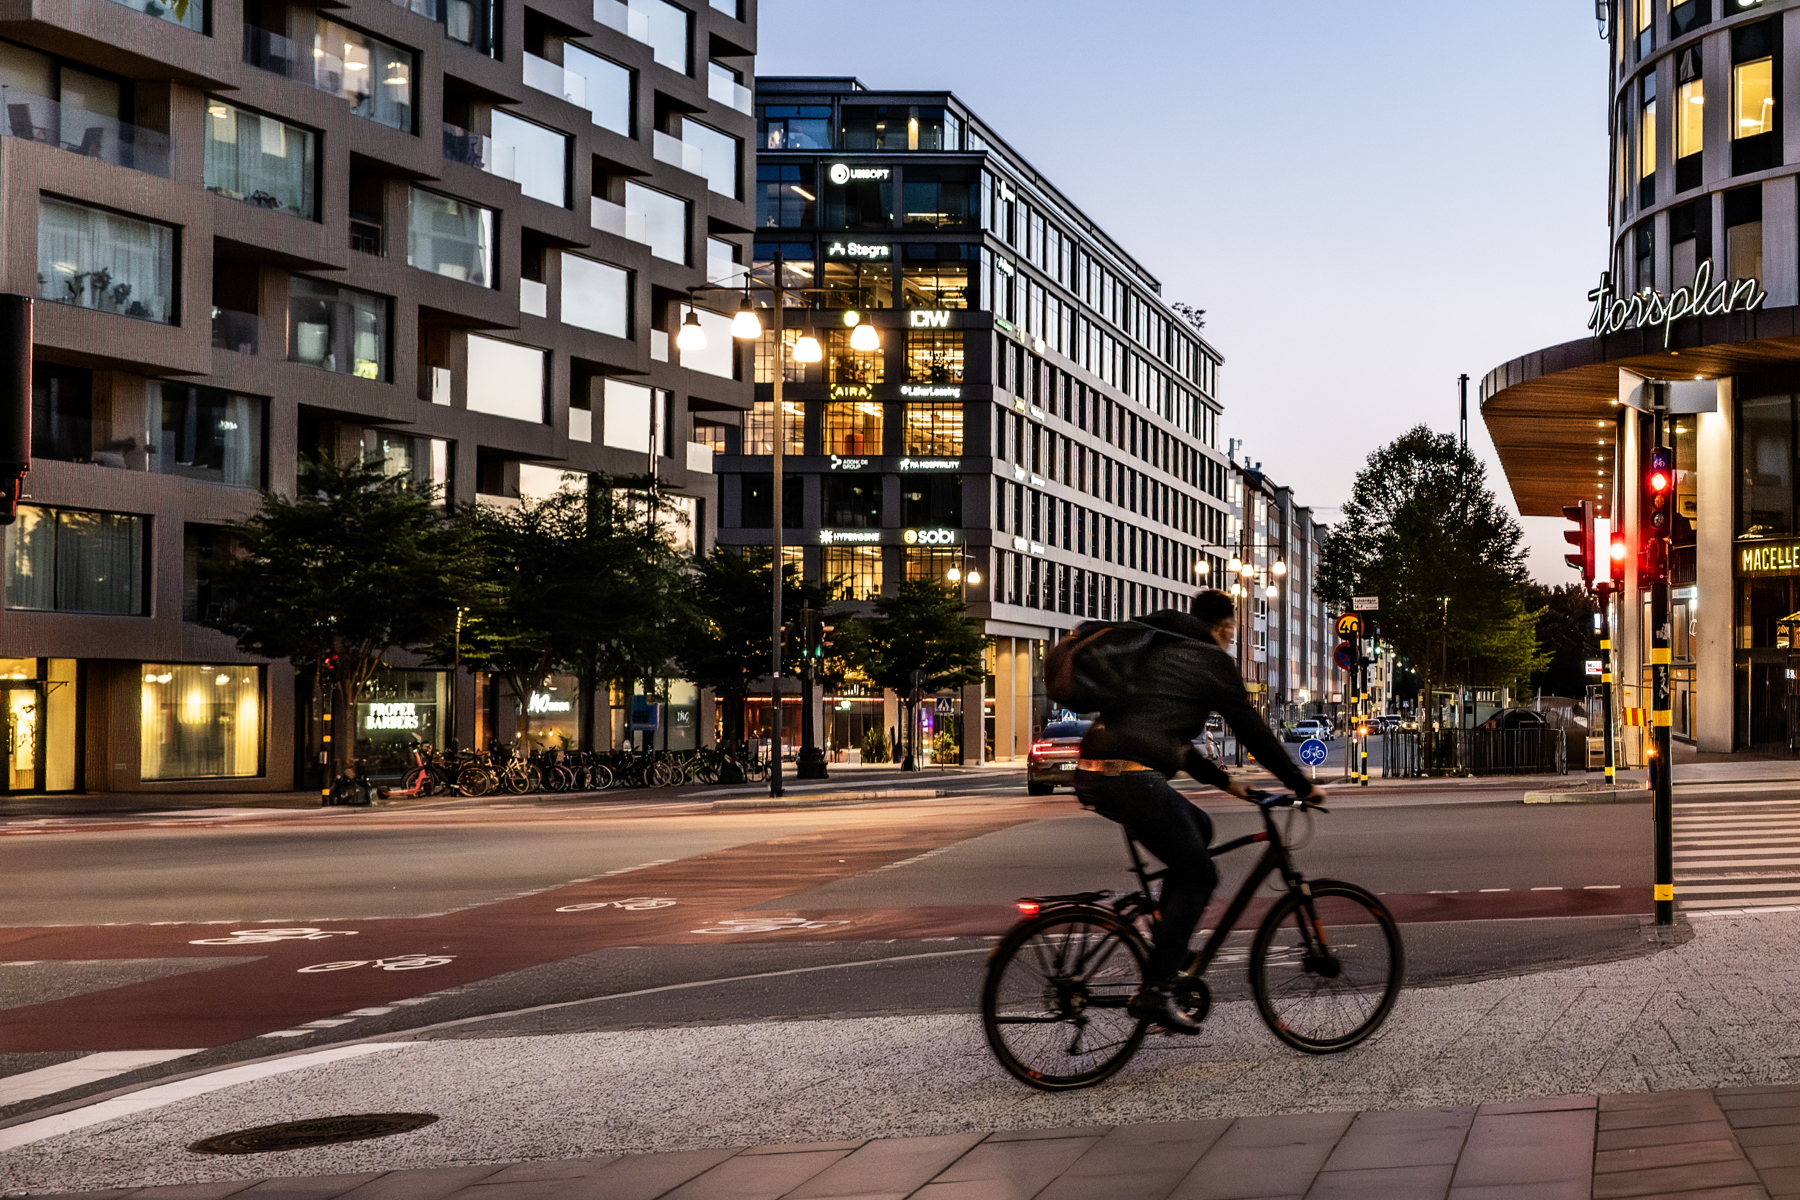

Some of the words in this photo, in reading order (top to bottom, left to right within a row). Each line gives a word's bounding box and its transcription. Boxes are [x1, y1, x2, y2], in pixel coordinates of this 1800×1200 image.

[851, 169, 889, 179] UBISOFT
[847, 242, 889, 258] Stegra
[1588, 259, 1766, 348] torsplan
[835, 386, 868, 397] AIRA
[918, 528, 954, 544] sobi
[1340, 620, 1360, 634] 40
[370, 702, 416, 716] PROPER
[366, 715, 419, 729] BARBERS
